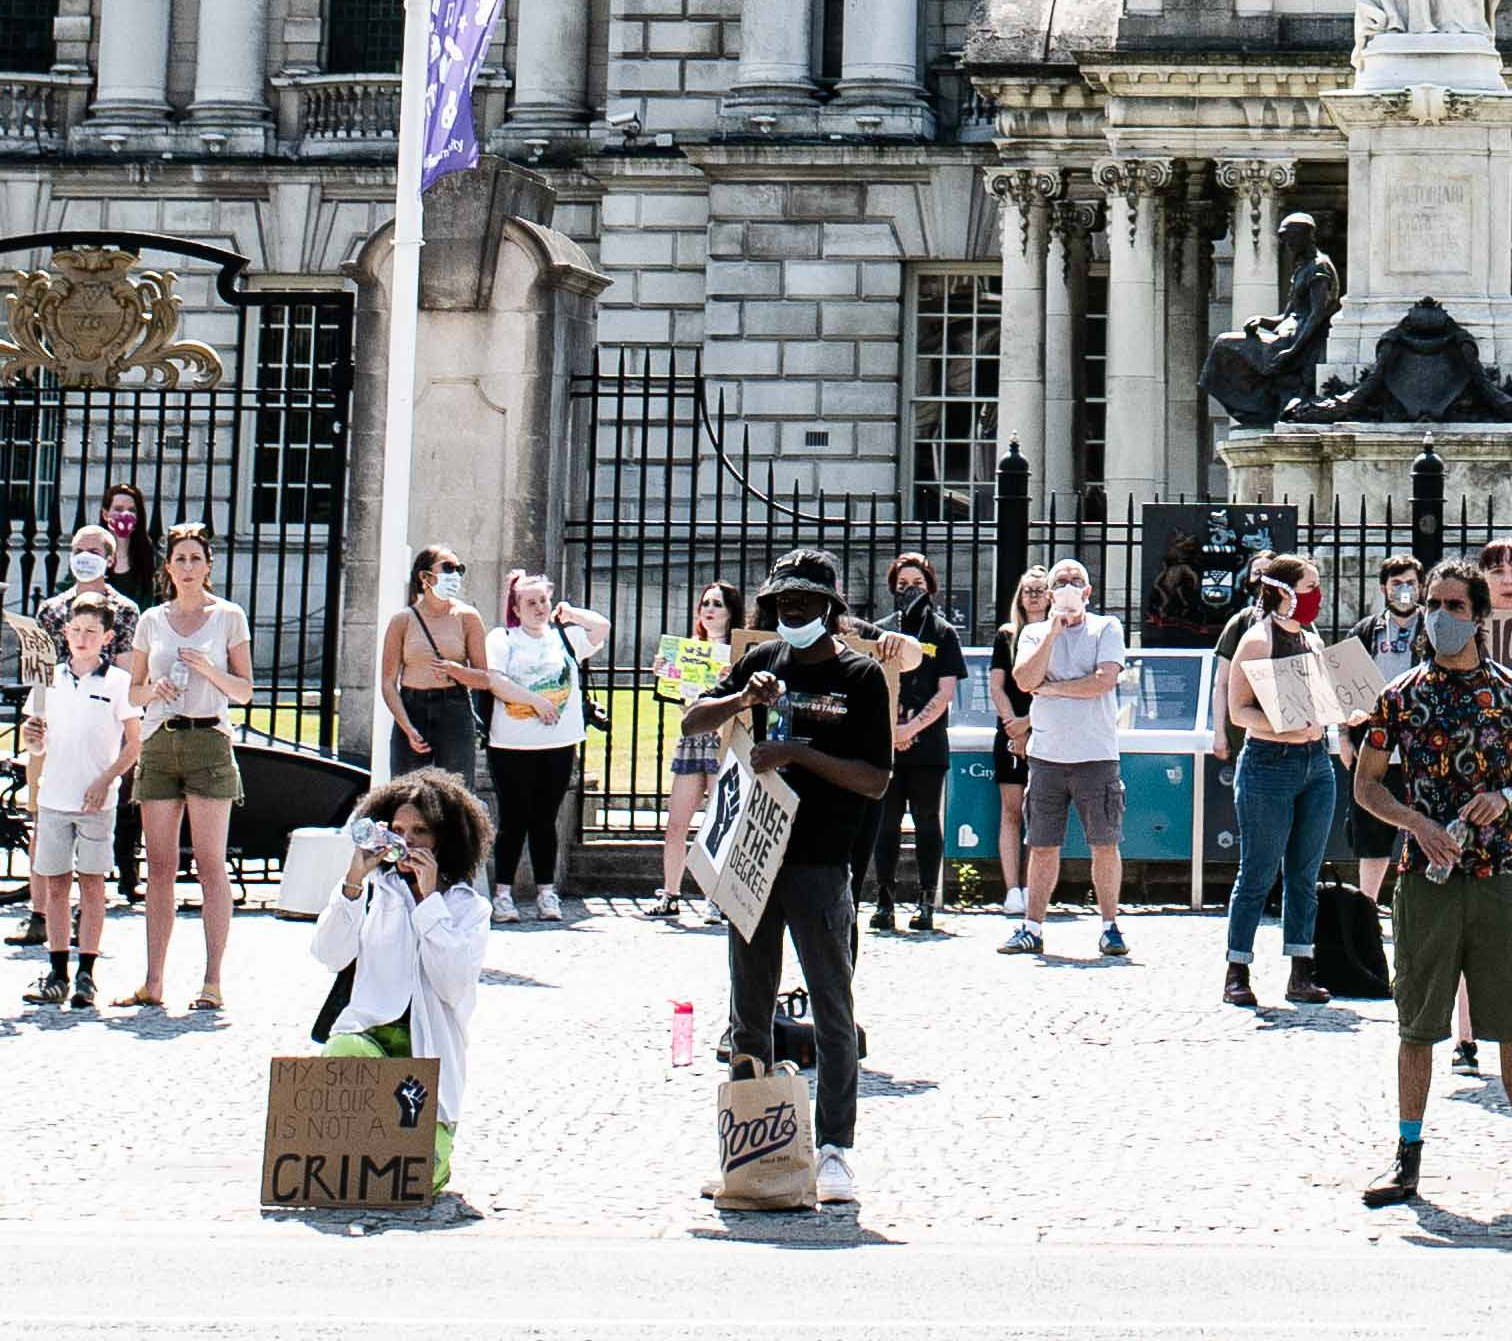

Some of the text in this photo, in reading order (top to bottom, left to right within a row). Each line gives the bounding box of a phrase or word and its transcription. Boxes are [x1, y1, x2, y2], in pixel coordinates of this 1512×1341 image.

[747, 778, 790, 846] RAISE
[741, 819, 773, 870] THE
[729, 844, 769, 903] DEGREE
[277, 1060, 382, 1087] MY SKIN
[293, 1087, 377, 1114] COLOUR
[271, 1115, 387, 1141] IS NOT A
[717, 1100, 799, 1174] Boots
[271, 1152, 428, 1203] CRIME
